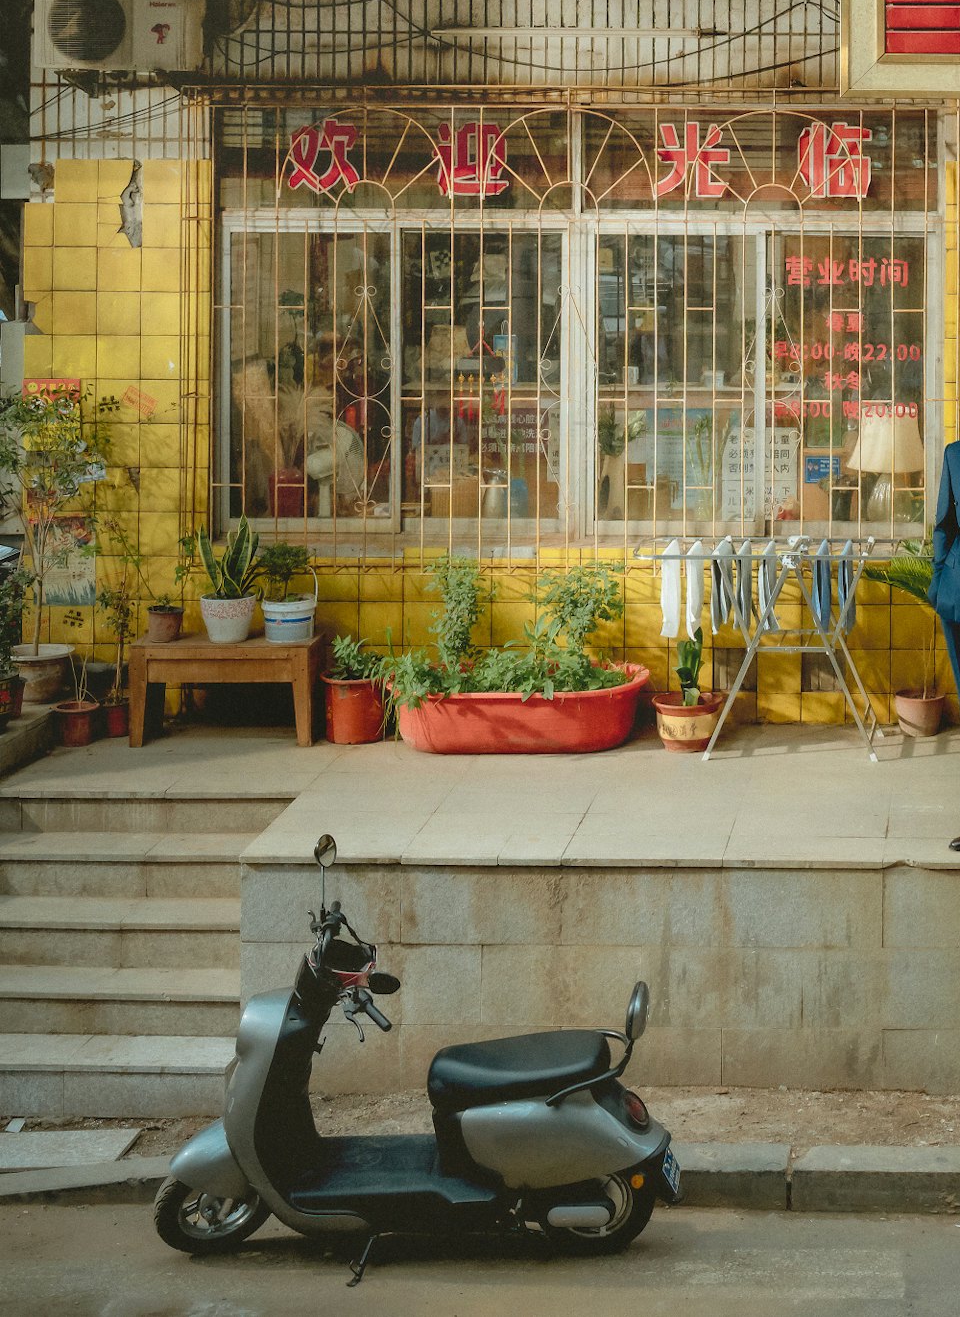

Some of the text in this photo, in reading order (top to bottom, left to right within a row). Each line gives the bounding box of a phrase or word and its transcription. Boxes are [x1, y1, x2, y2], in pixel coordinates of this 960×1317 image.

[288, 118, 872, 199] 欢迎光临
[785, 256, 909, 288] 营业时间
